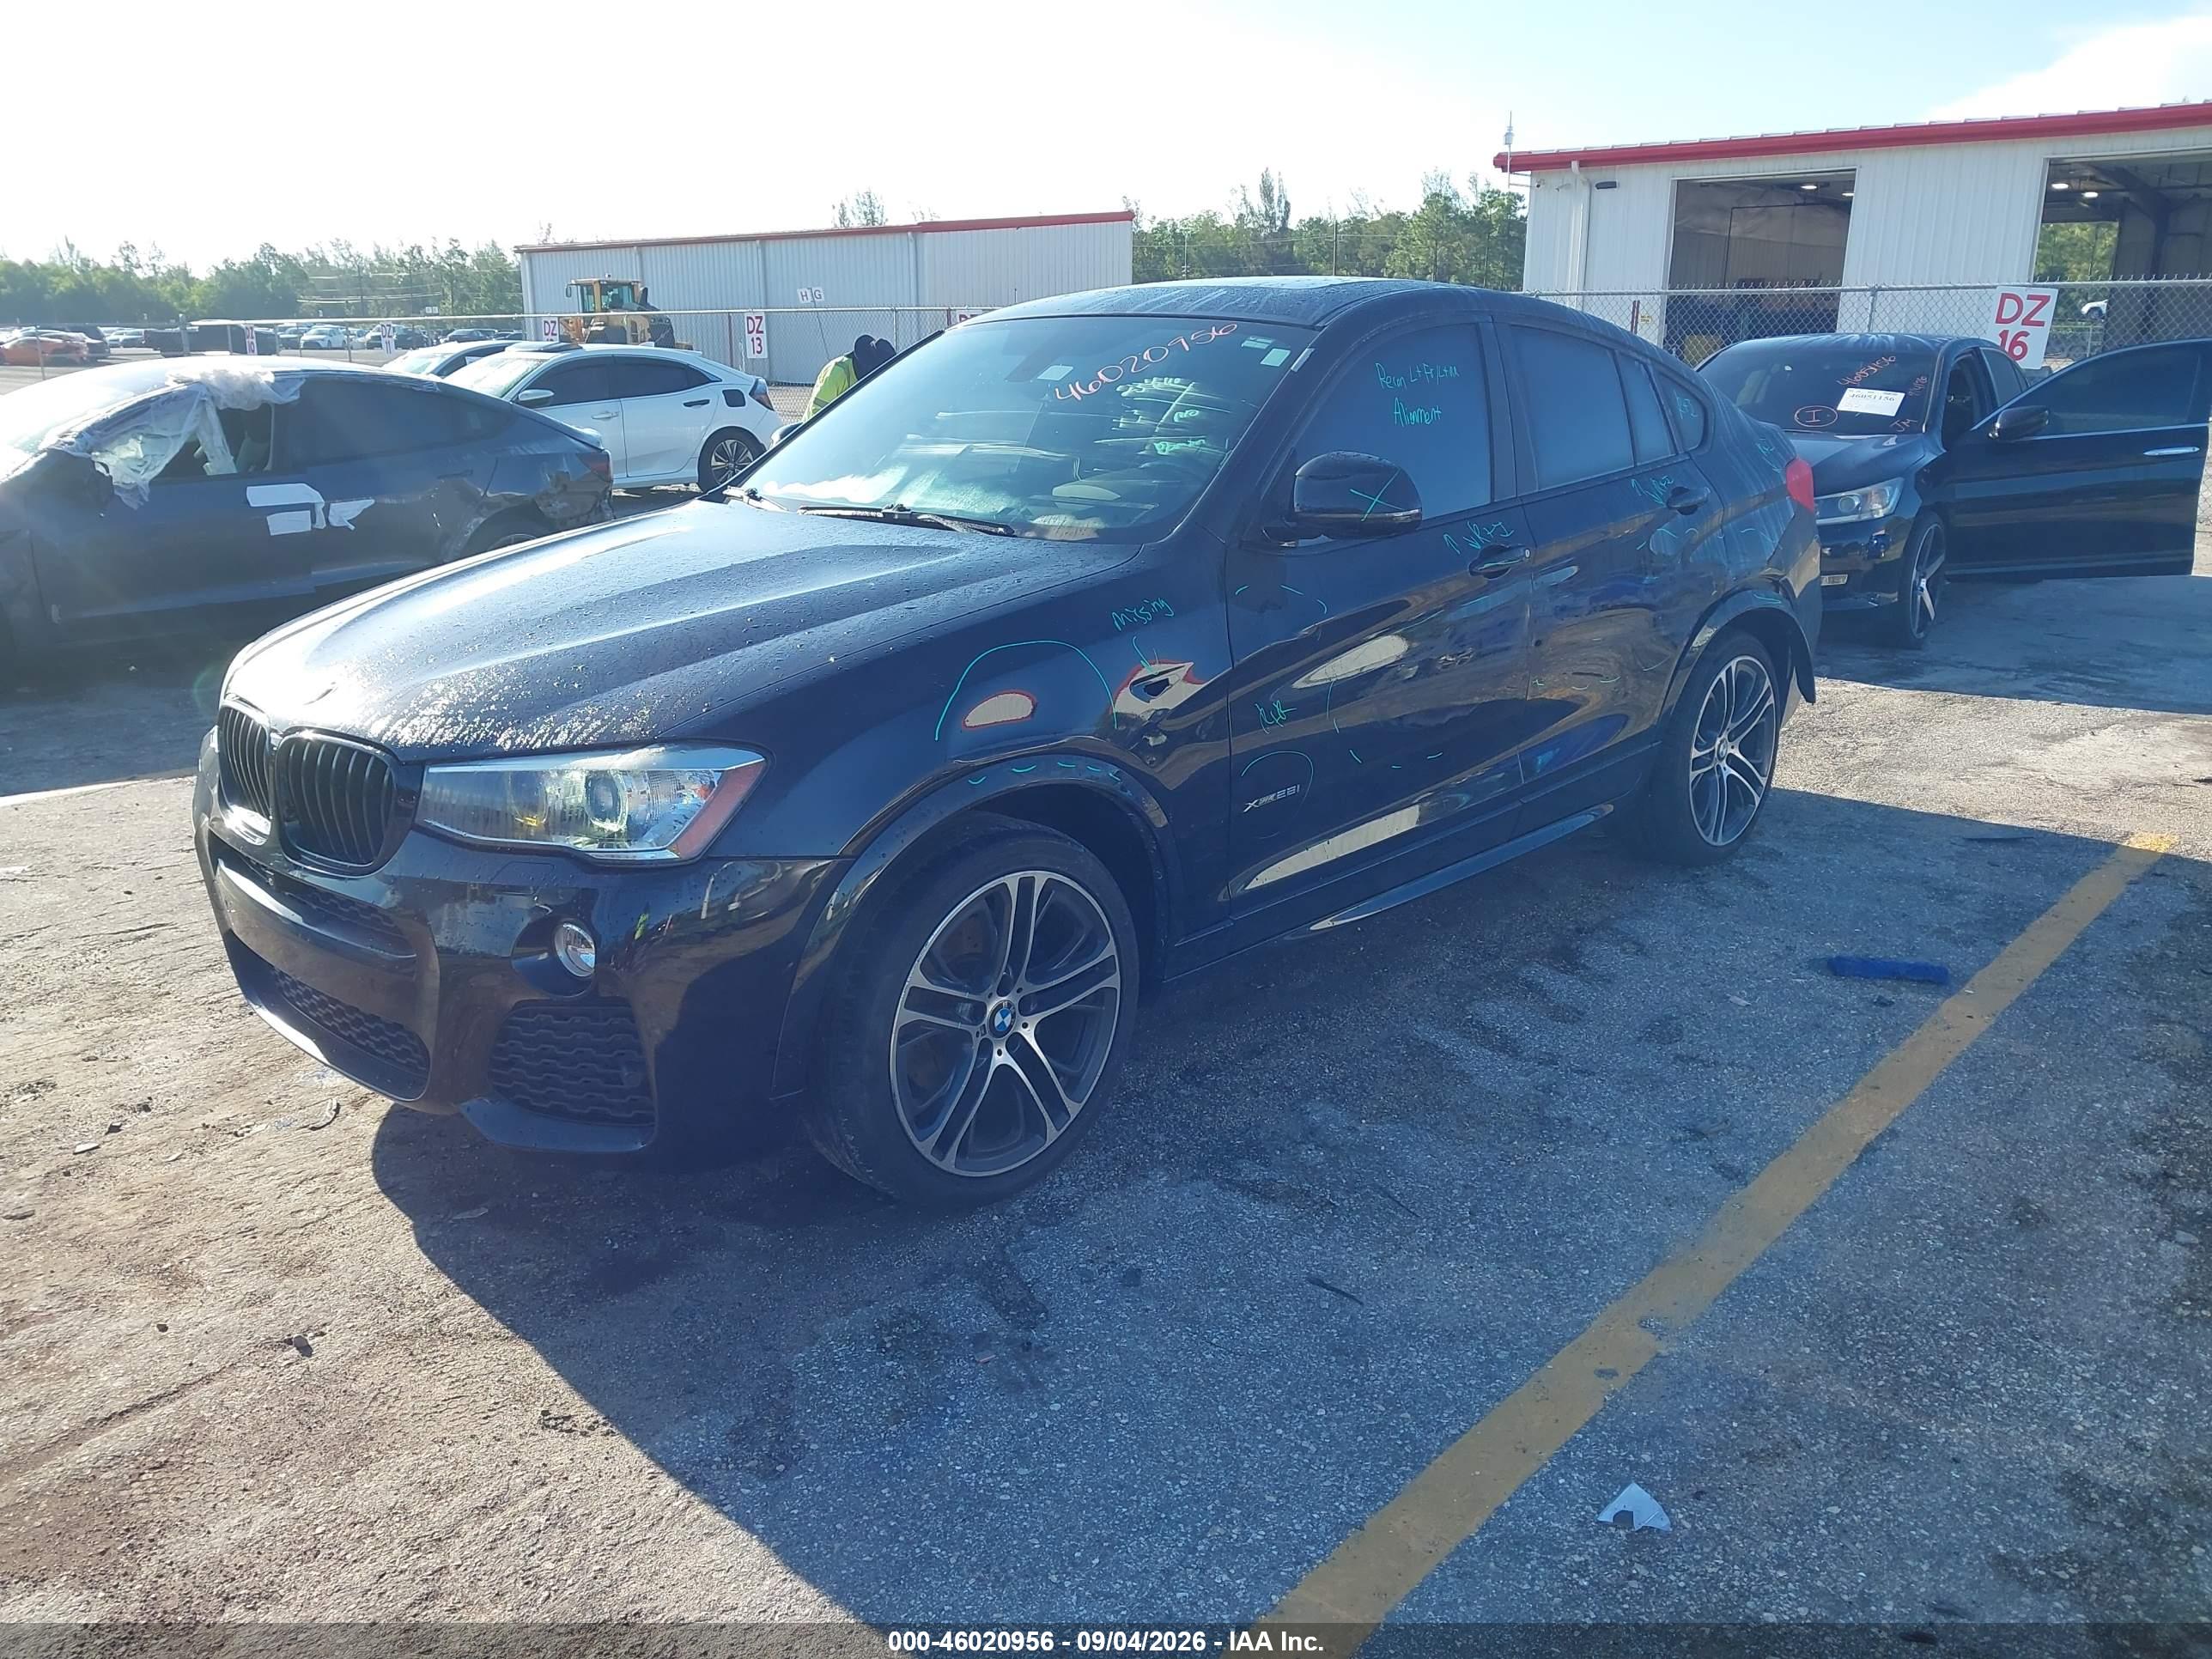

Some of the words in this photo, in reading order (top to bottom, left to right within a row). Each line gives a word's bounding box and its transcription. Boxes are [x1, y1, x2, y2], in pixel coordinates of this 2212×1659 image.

[1995, 292, 2051, 327] DZ
[380, 324, 392, 338] DZ
[544, 319, 557, 336] DZ
[746, 315, 764, 334] DZ
[750, 336, 763, 355] 13
[1998, 329, 2031, 362] 16
